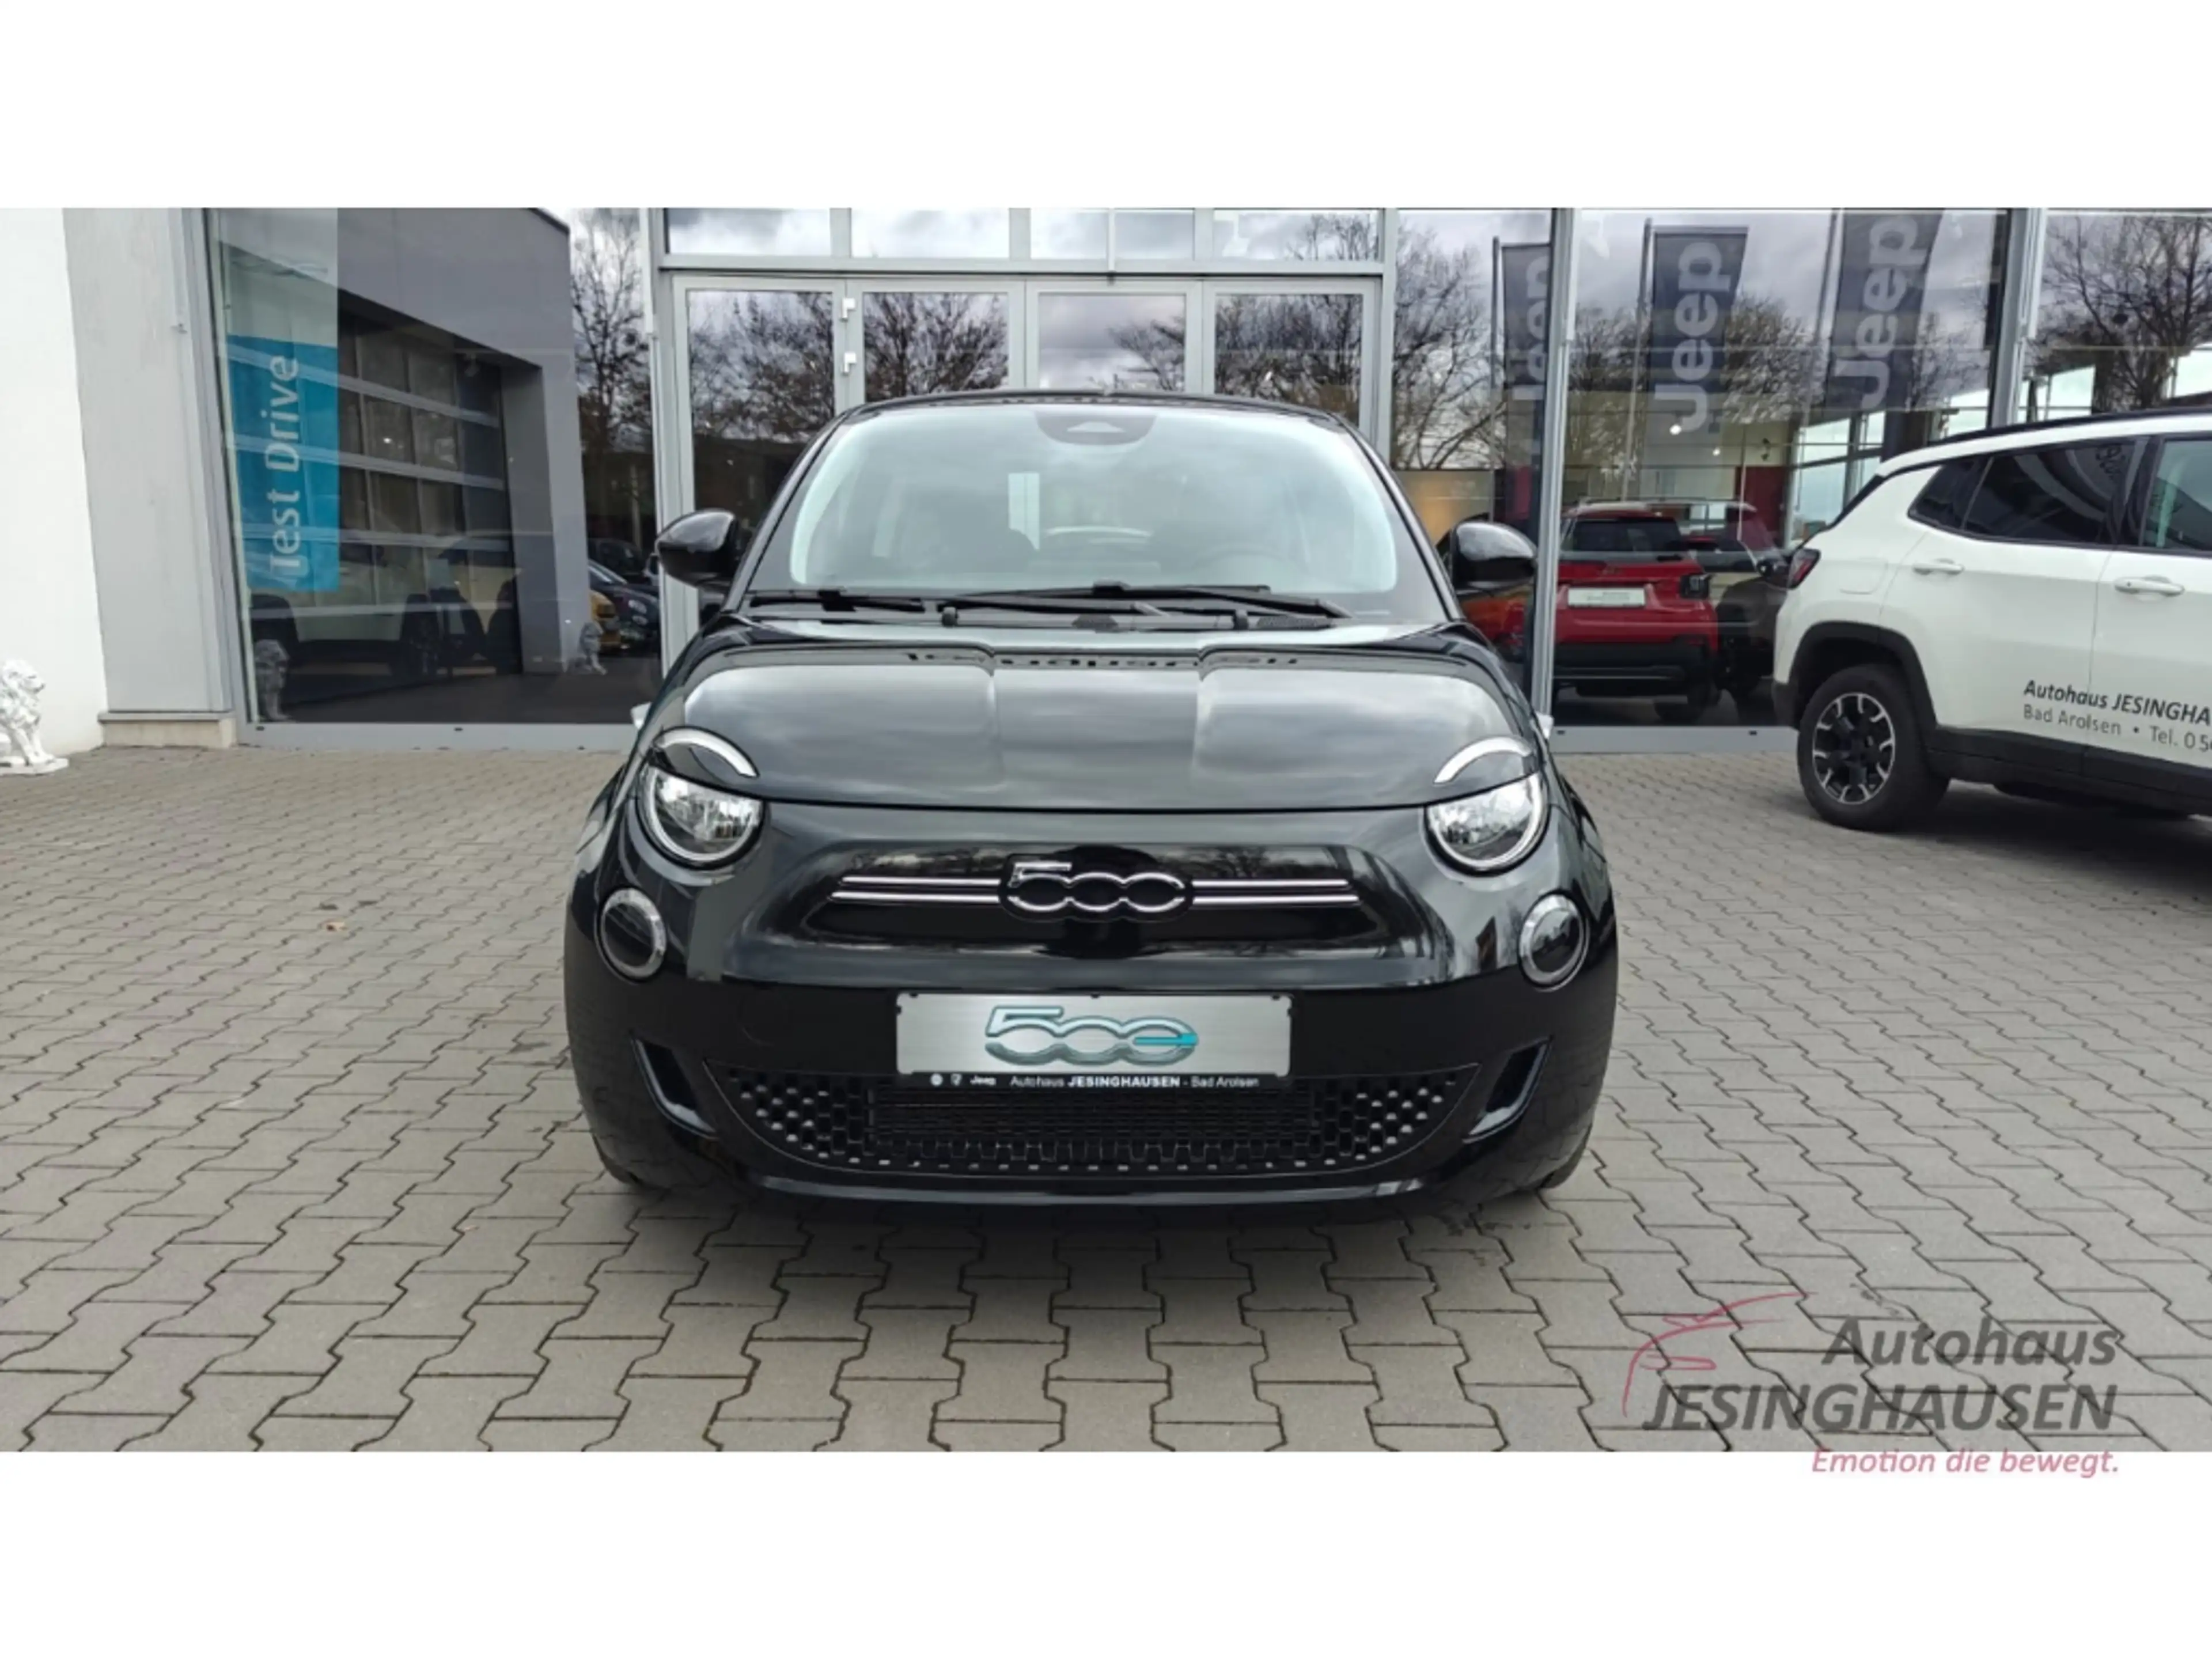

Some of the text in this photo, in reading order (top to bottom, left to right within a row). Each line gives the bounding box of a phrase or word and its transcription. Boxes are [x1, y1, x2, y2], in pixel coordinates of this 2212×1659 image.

[1654, 242, 1730, 431] Jeep
[1834, 216, 1928, 409] Jeep
[260, 355, 300, 573] Test Drive
[2024, 680, 2108, 709] Autohaus
[2024, 704, 2053, 724] Bad
[2058, 711, 2122, 736] Arolsen
[2150, 725, 2178, 747] Tel.
[1007, 862, 1185, 913] 500
[1010, 1075, 1065, 1088] Autohaus
[1067, 1075, 1180, 1088] JESINGHAUSEN
